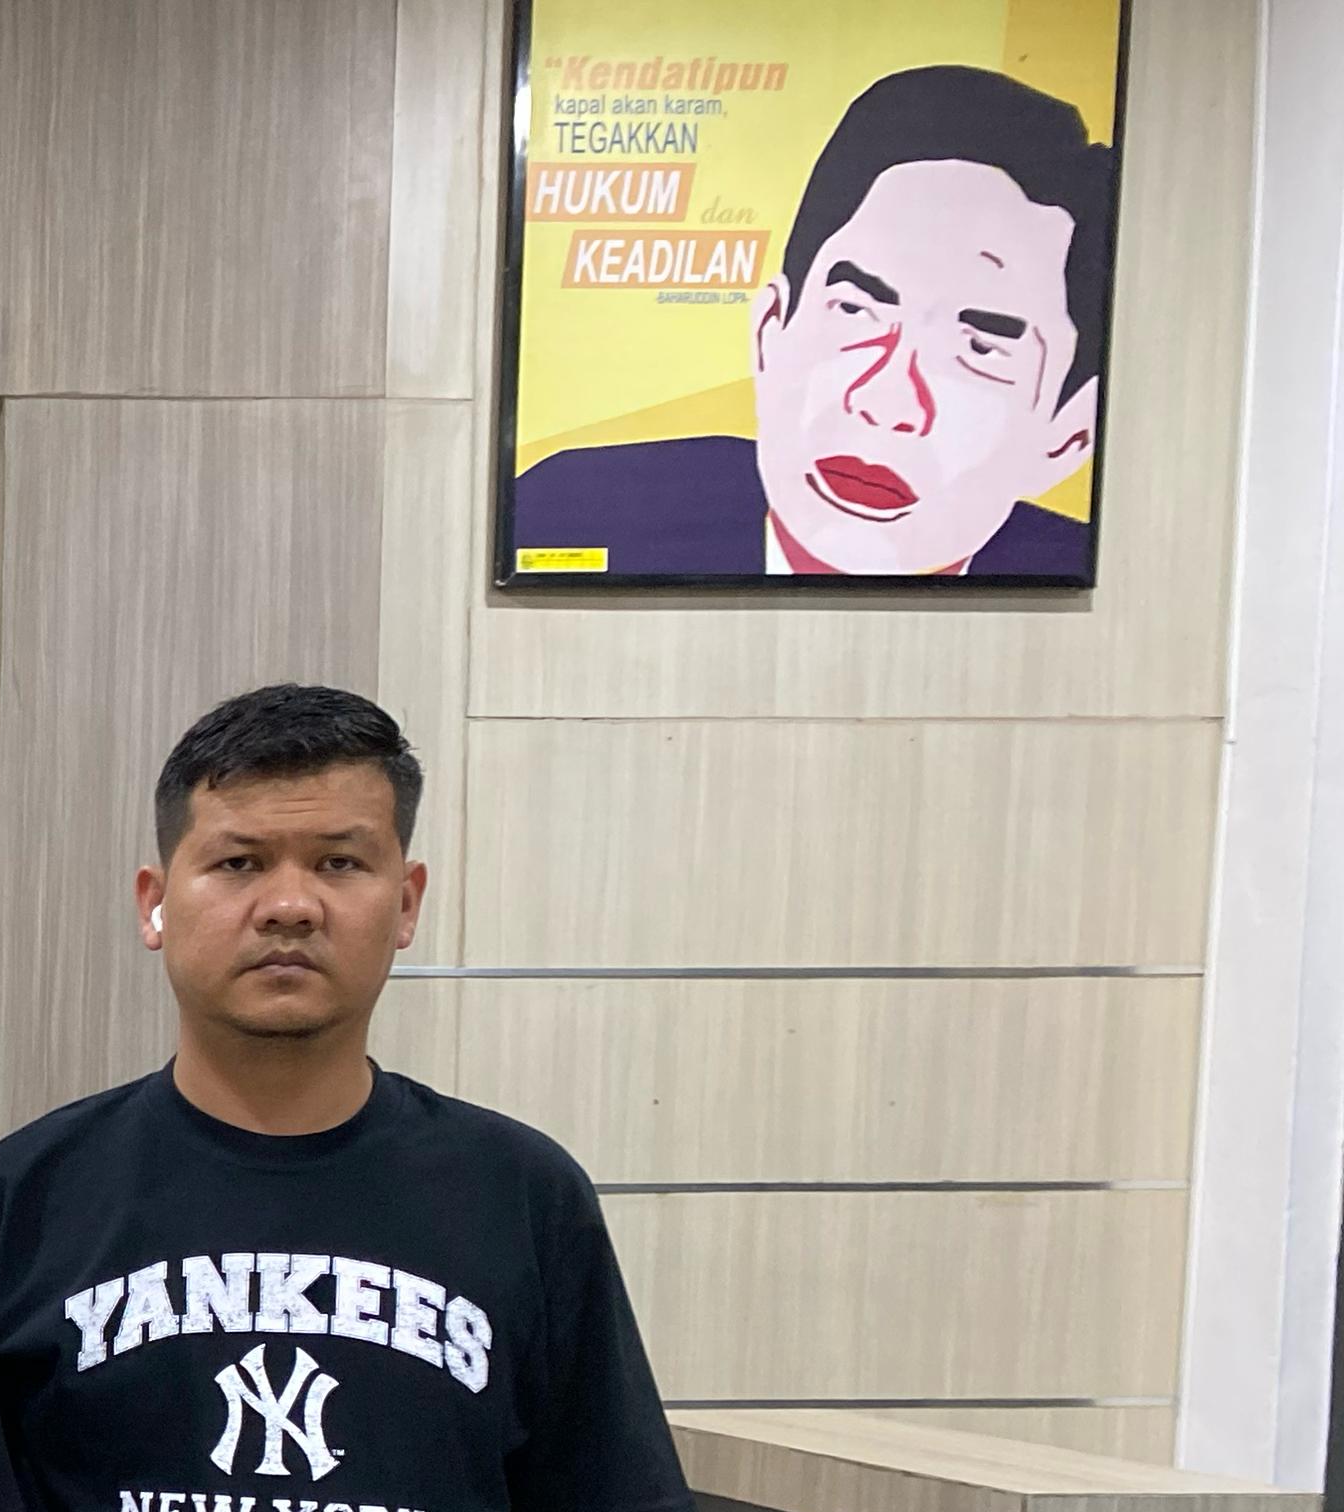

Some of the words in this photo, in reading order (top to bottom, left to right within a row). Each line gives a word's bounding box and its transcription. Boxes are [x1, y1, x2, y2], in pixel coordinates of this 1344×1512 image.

[554, 95, 606, 118] kapal
[612, 97, 657, 115] akan
[663, 95, 728, 117] karam,
[554, 121, 699, 154] TEGAKKAN
[533, 169, 682, 215] HUKUM
[700, 196, 758, 225] dan
[572, 238, 759, 284] KEADILAN
[64, 1251, 495, 1395] YANKEES
